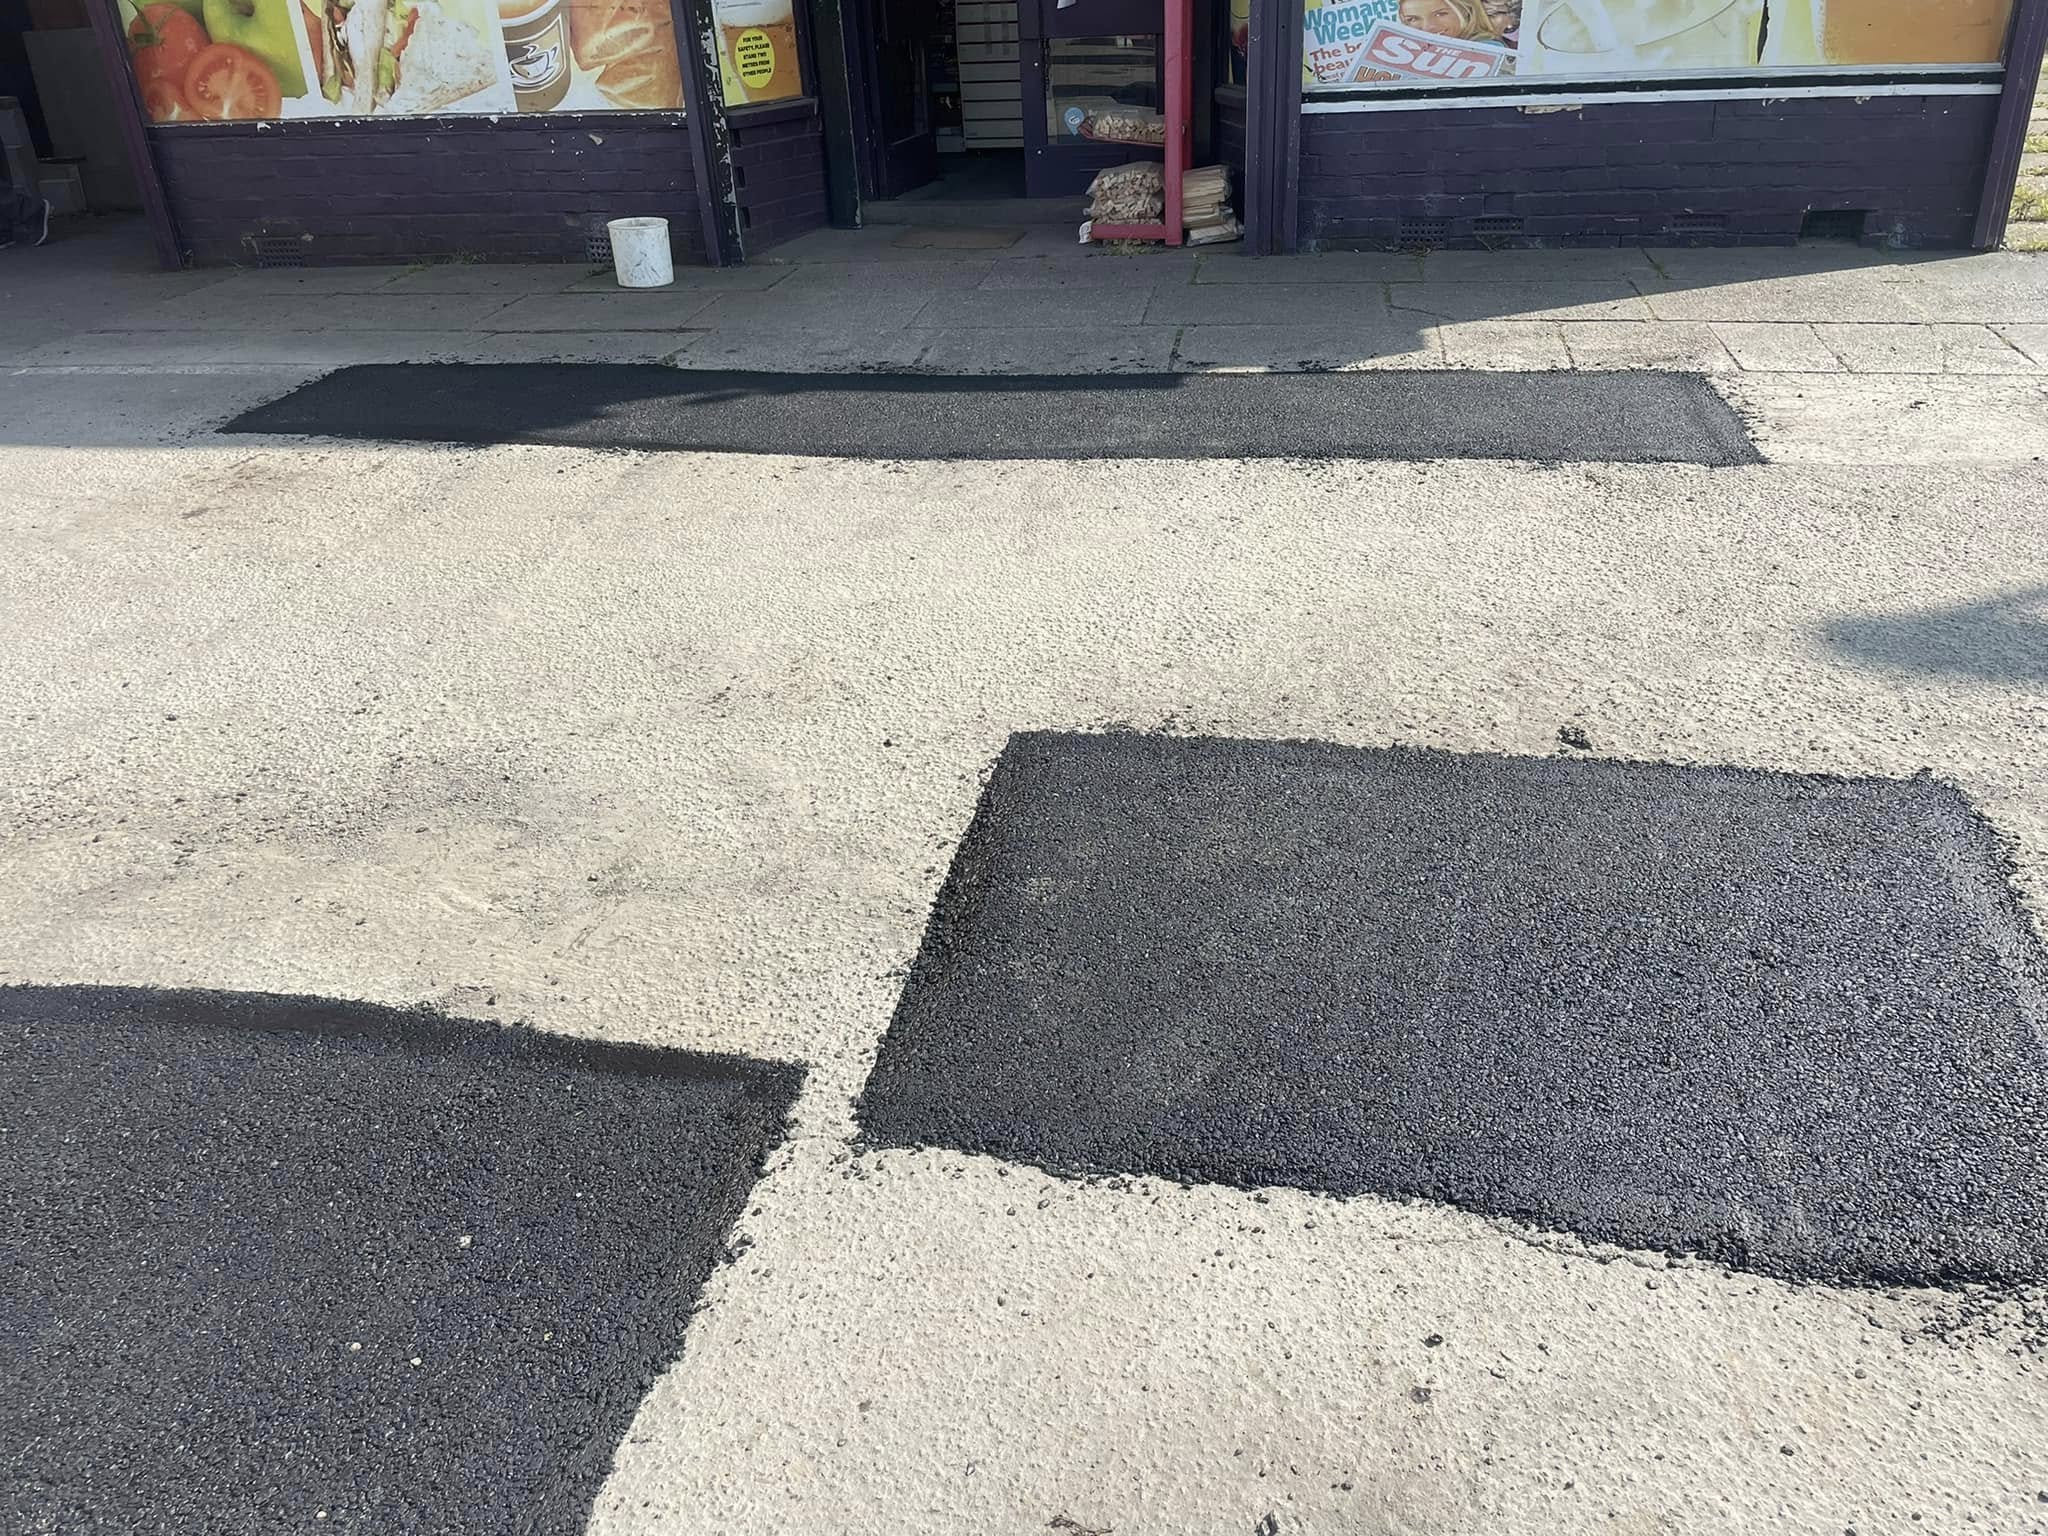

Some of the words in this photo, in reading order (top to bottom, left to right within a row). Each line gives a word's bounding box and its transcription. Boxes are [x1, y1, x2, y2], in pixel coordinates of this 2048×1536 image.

[1309, 47, 1342, 62] The
[1372, 35, 1490, 78] Sun
[1434, 46, 1462, 57] THE
